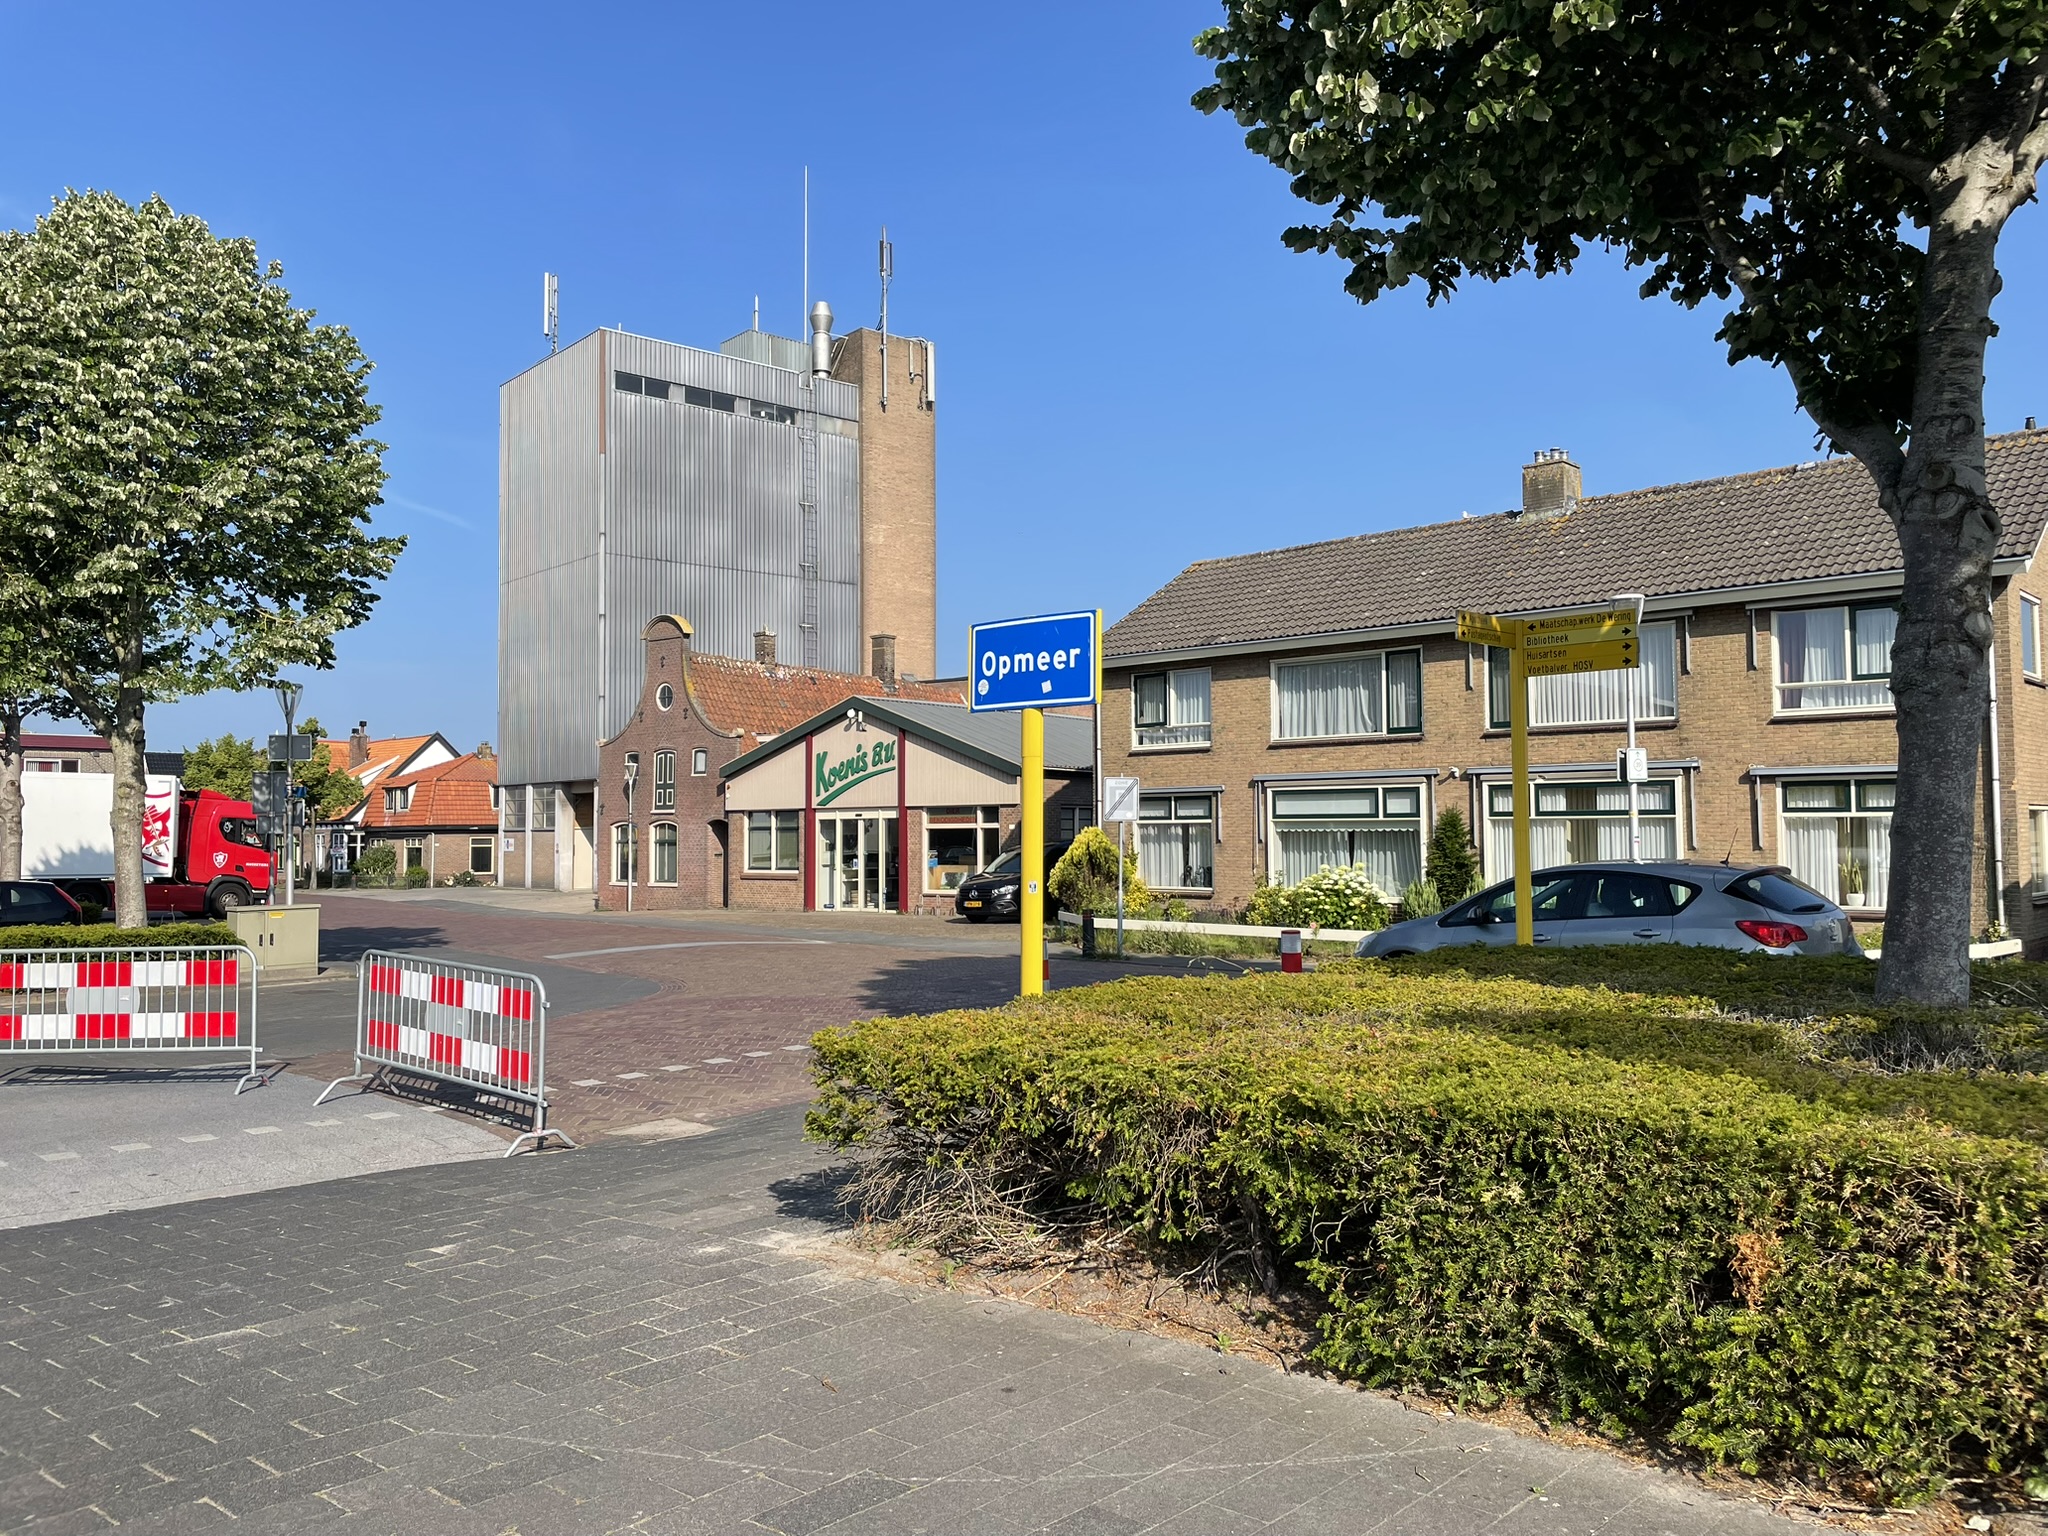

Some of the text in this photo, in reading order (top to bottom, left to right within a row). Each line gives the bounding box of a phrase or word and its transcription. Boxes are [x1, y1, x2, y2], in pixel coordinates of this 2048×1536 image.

[1540, 611, 1631, 629] Maatschap.werk De Wering
[1526, 633, 1569, 647] Bibliotheek
[1526, 649, 1567, 660] Huisartsen
[981, 647, 1081, 681] Opmeer
[1527, 659, 1594, 675] Voetbalver. HOSV
[815, 743, 868, 798] Koenis
